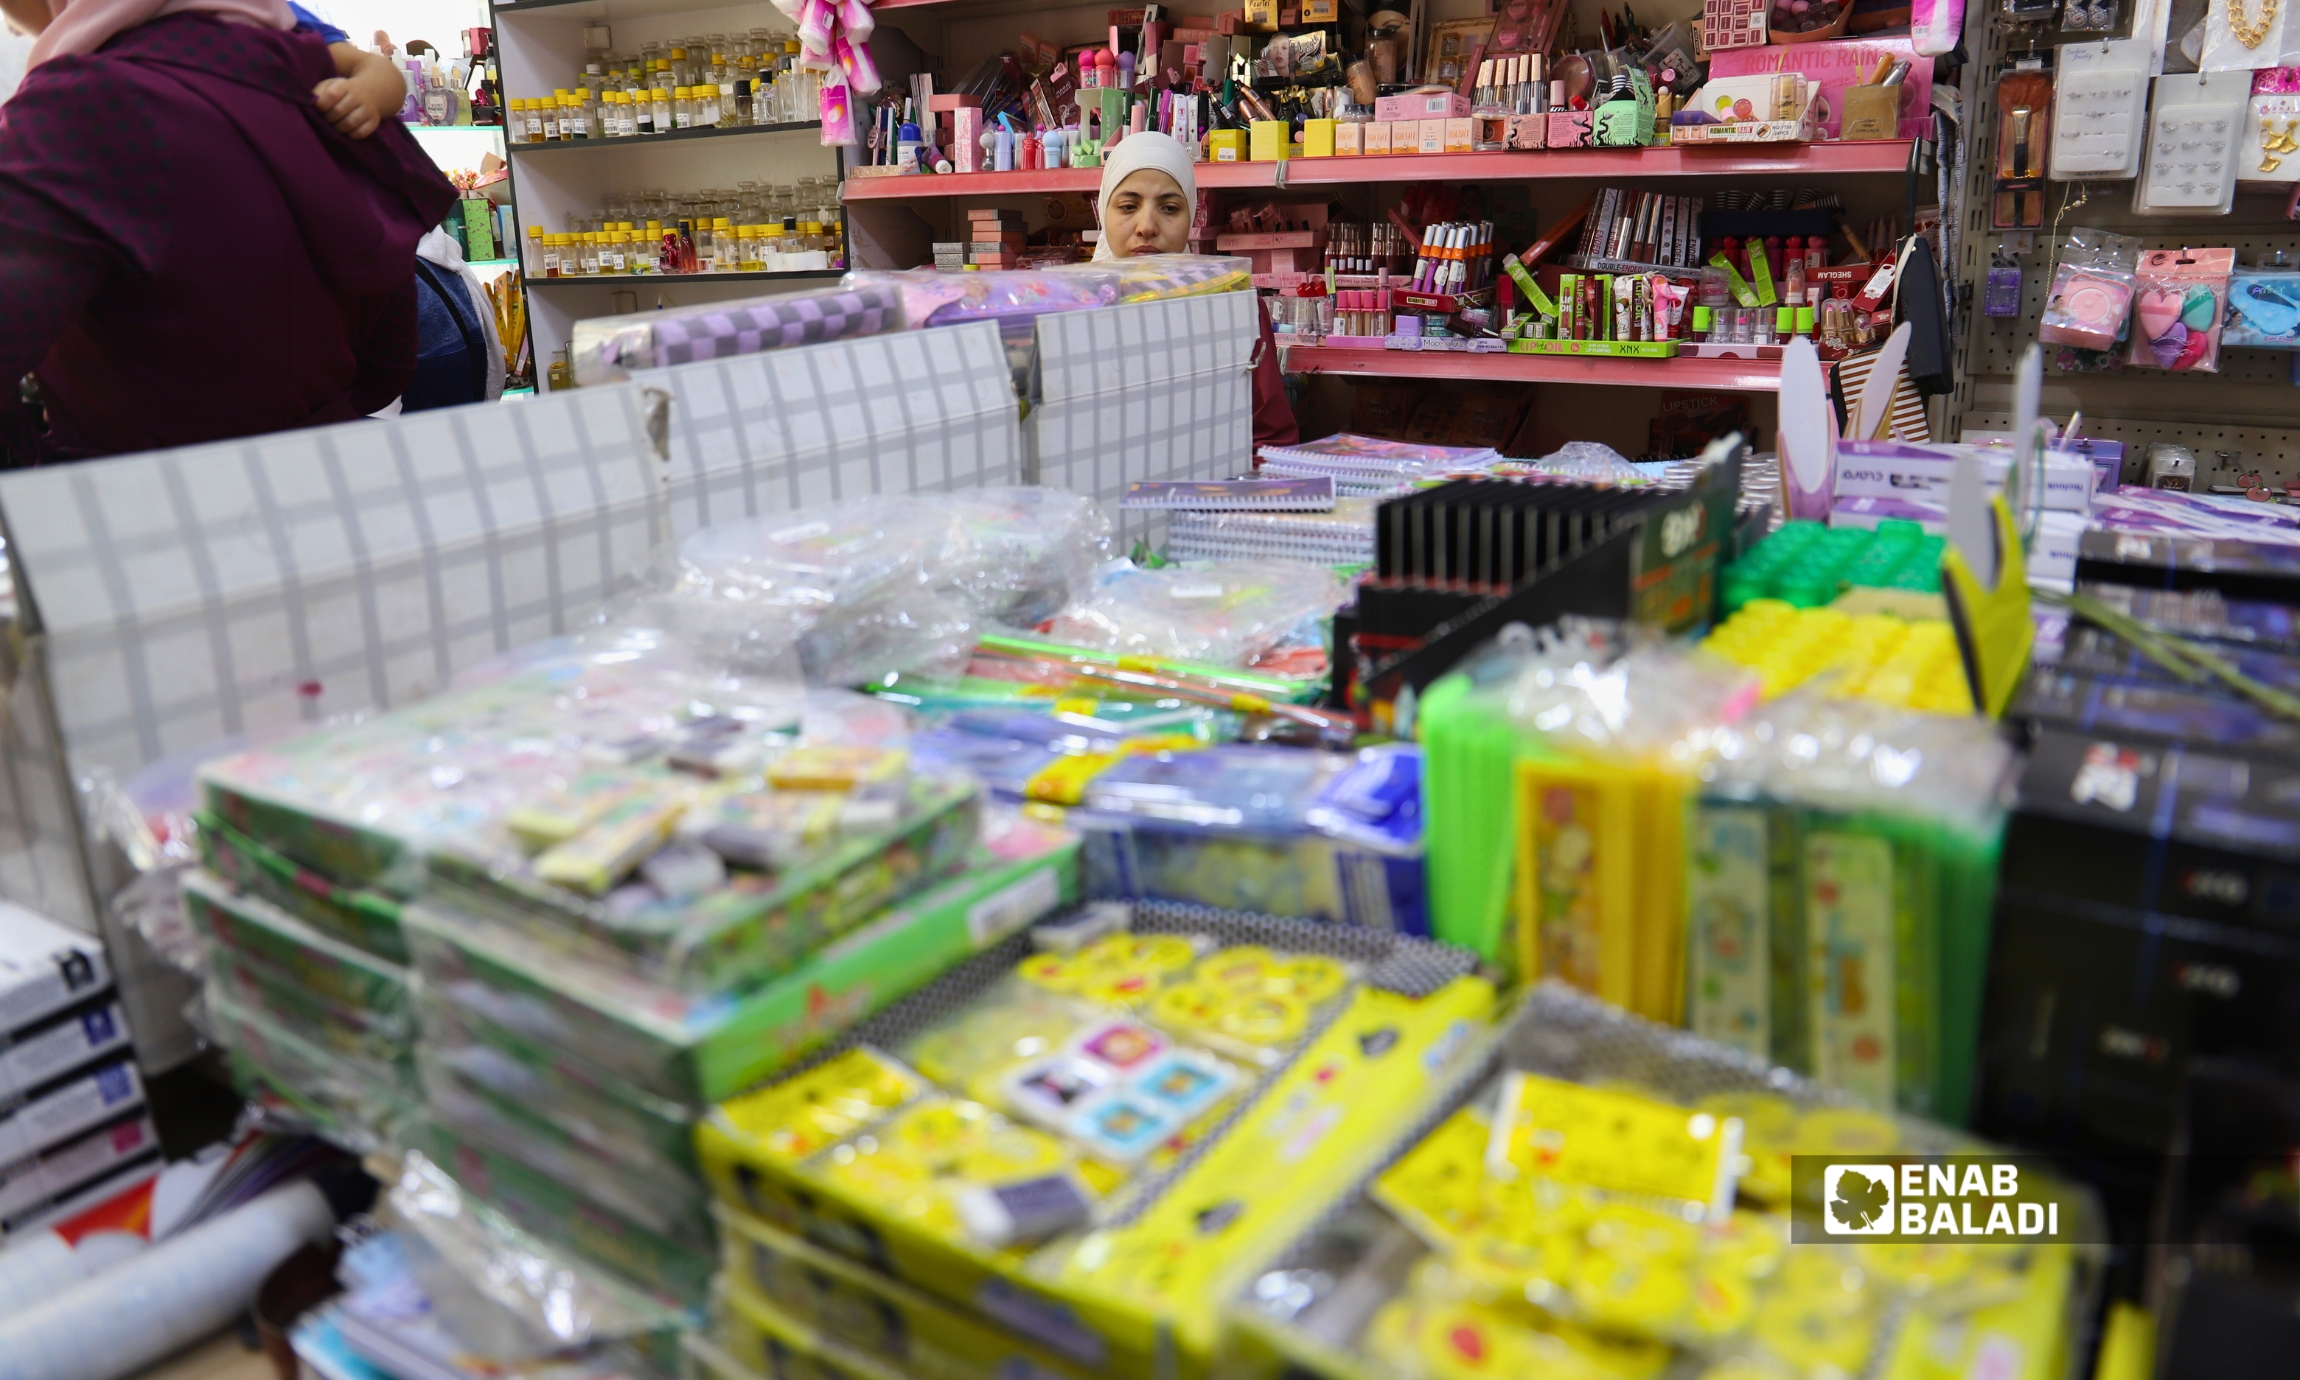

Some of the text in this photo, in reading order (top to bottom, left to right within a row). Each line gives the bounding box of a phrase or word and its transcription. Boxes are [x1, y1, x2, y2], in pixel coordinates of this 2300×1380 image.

[1744, 48, 1879, 73] ROMANTIC RAIN
[1593, 230, 1604, 254] ENDED
[1674, 239, 1683, 263] ENDED
[1597, 262, 1643, 274] DOUBLE-ENDED
[1817, 271, 1852, 279] SHEGLAM
[1560, 296, 1573, 304] LIP
[1560, 304, 1573, 312] OIL
[1520, 342, 1564, 352] LIP OIL
[1620, 345, 1640, 354] XNX
[1662, 396, 1718, 412] LIPSTICK
